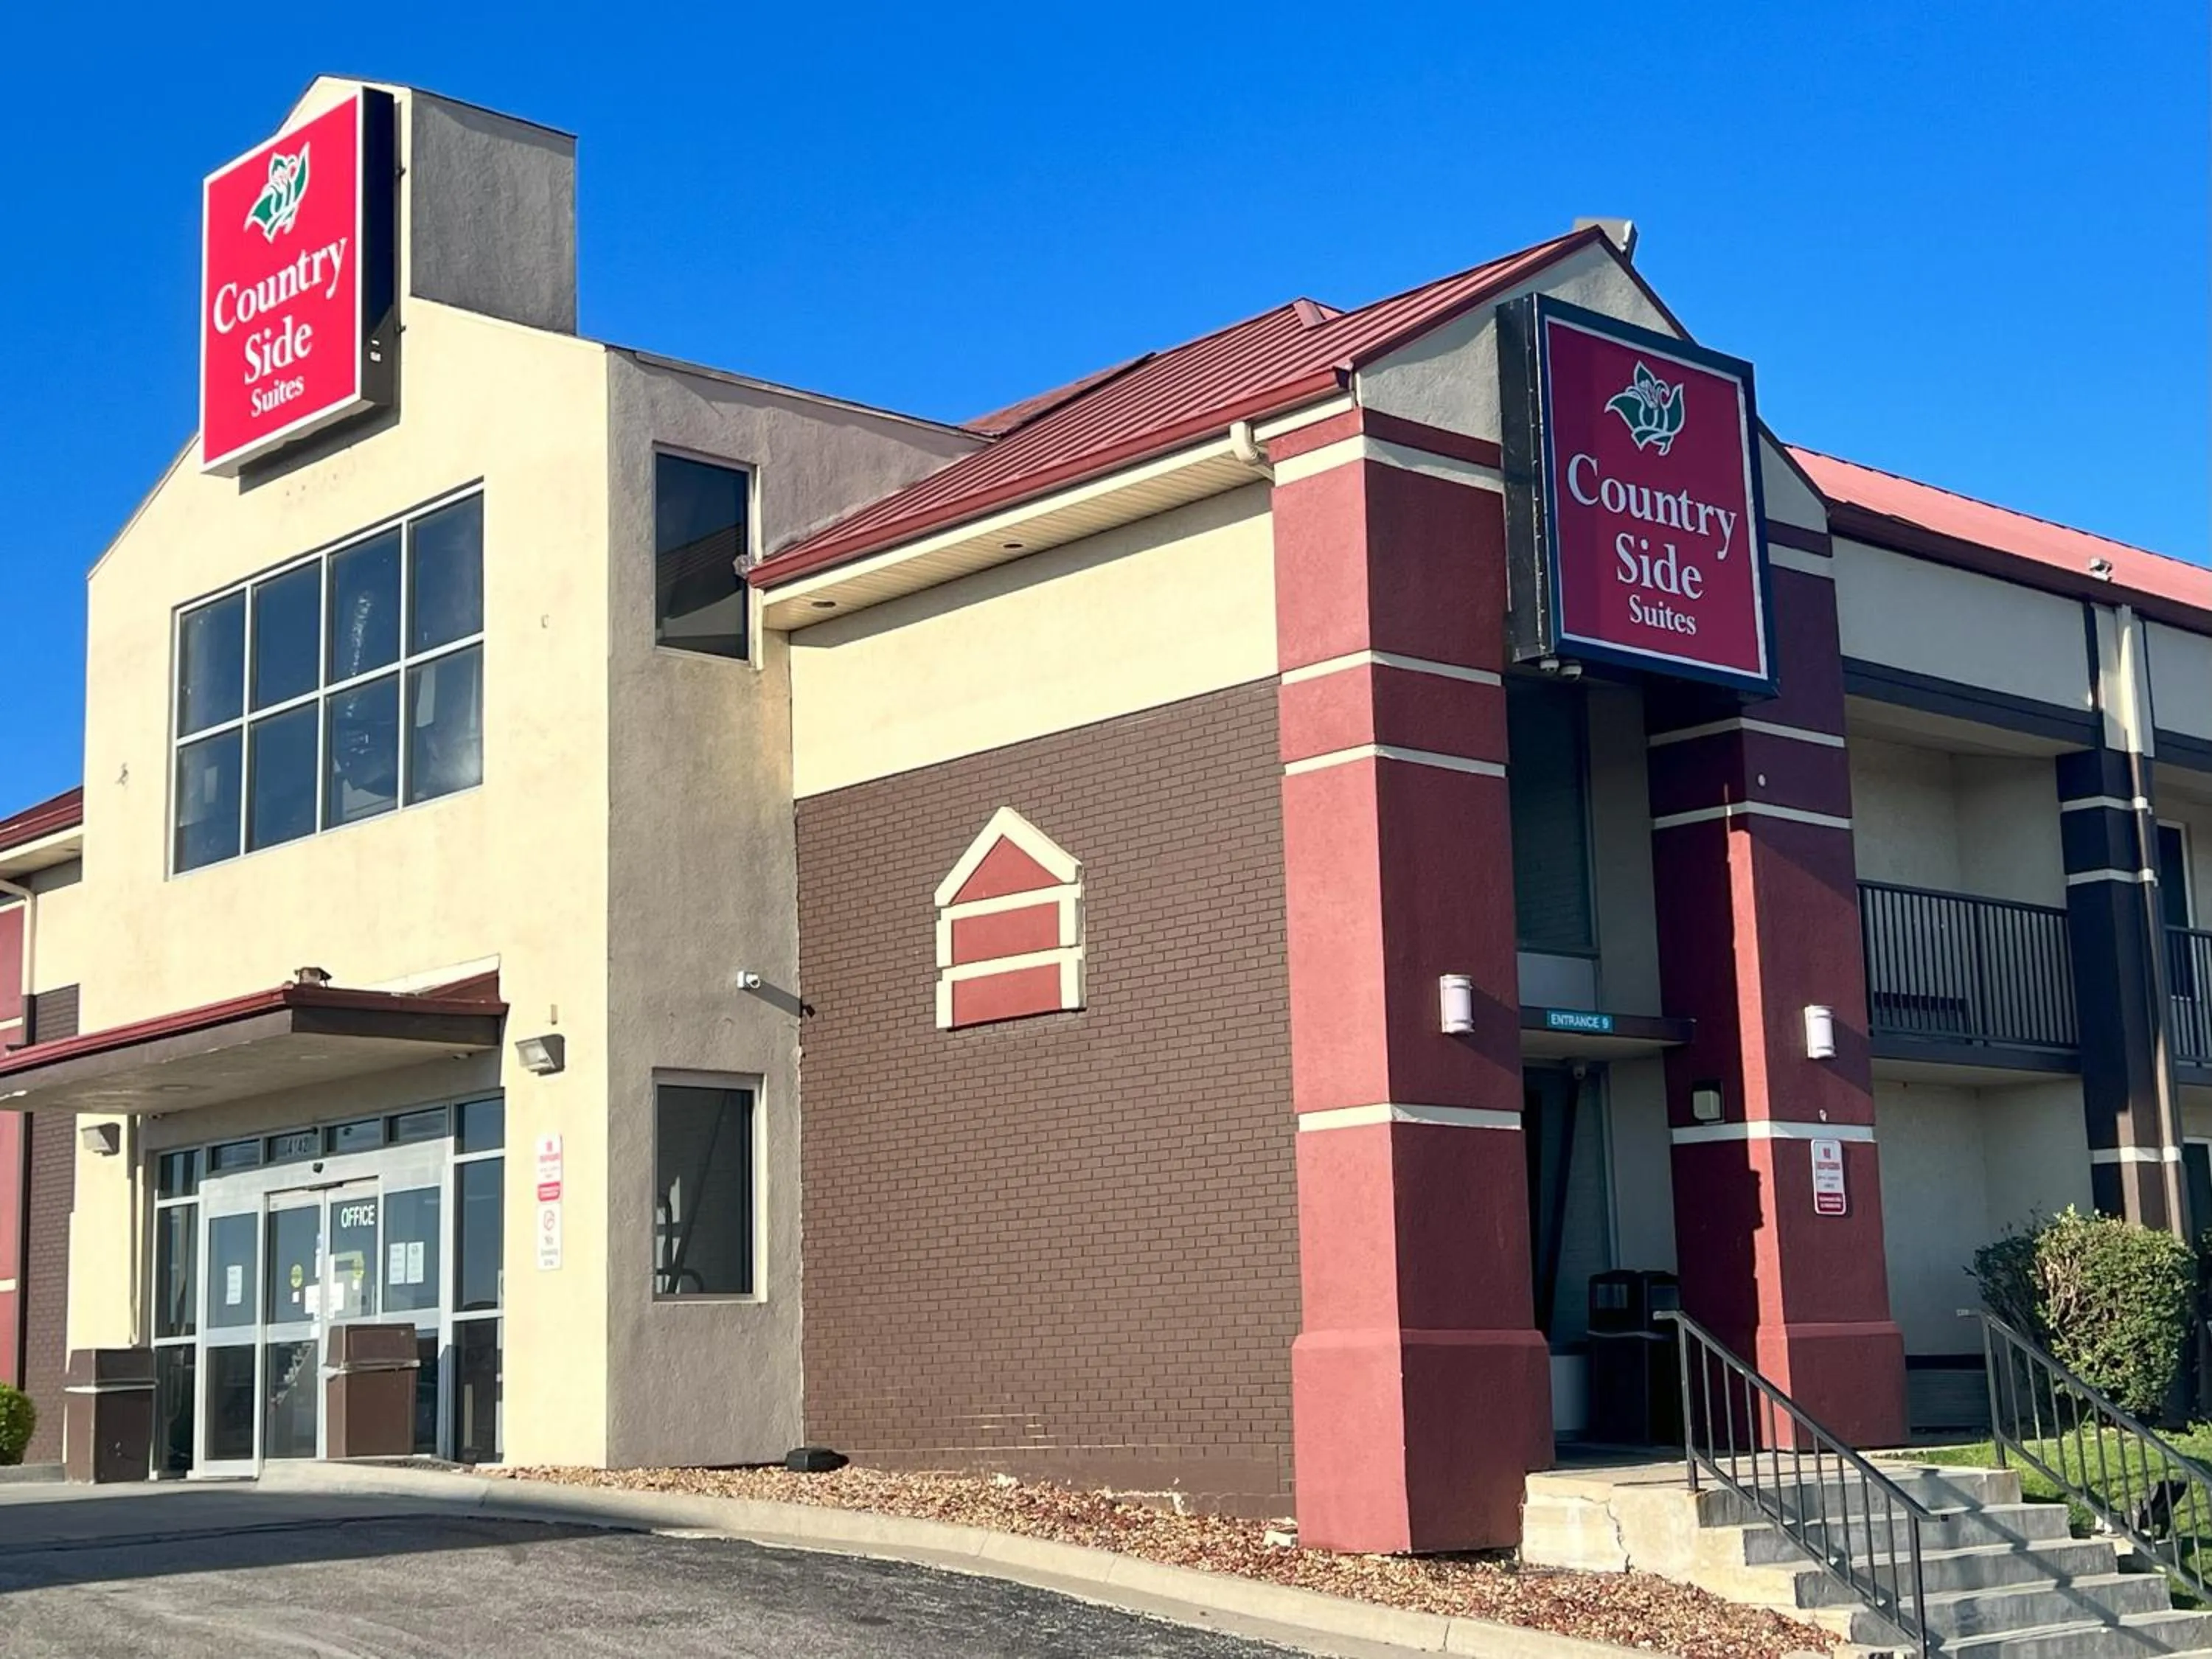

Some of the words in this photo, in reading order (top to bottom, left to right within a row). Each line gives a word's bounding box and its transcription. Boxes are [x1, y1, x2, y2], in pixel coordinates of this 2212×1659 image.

[213, 237, 347, 335] Country
[243, 315, 313, 385] Side
[251, 375, 305, 418] Suites
[1567, 453, 1738, 560] Country
[1615, 532, 1705, 600] Side
[1628, 595, 1697, 636] Suites
[1551, 1013, 1599, 1029] ENTRANCE
[341, 1204, 375, 1229] OFFICE
